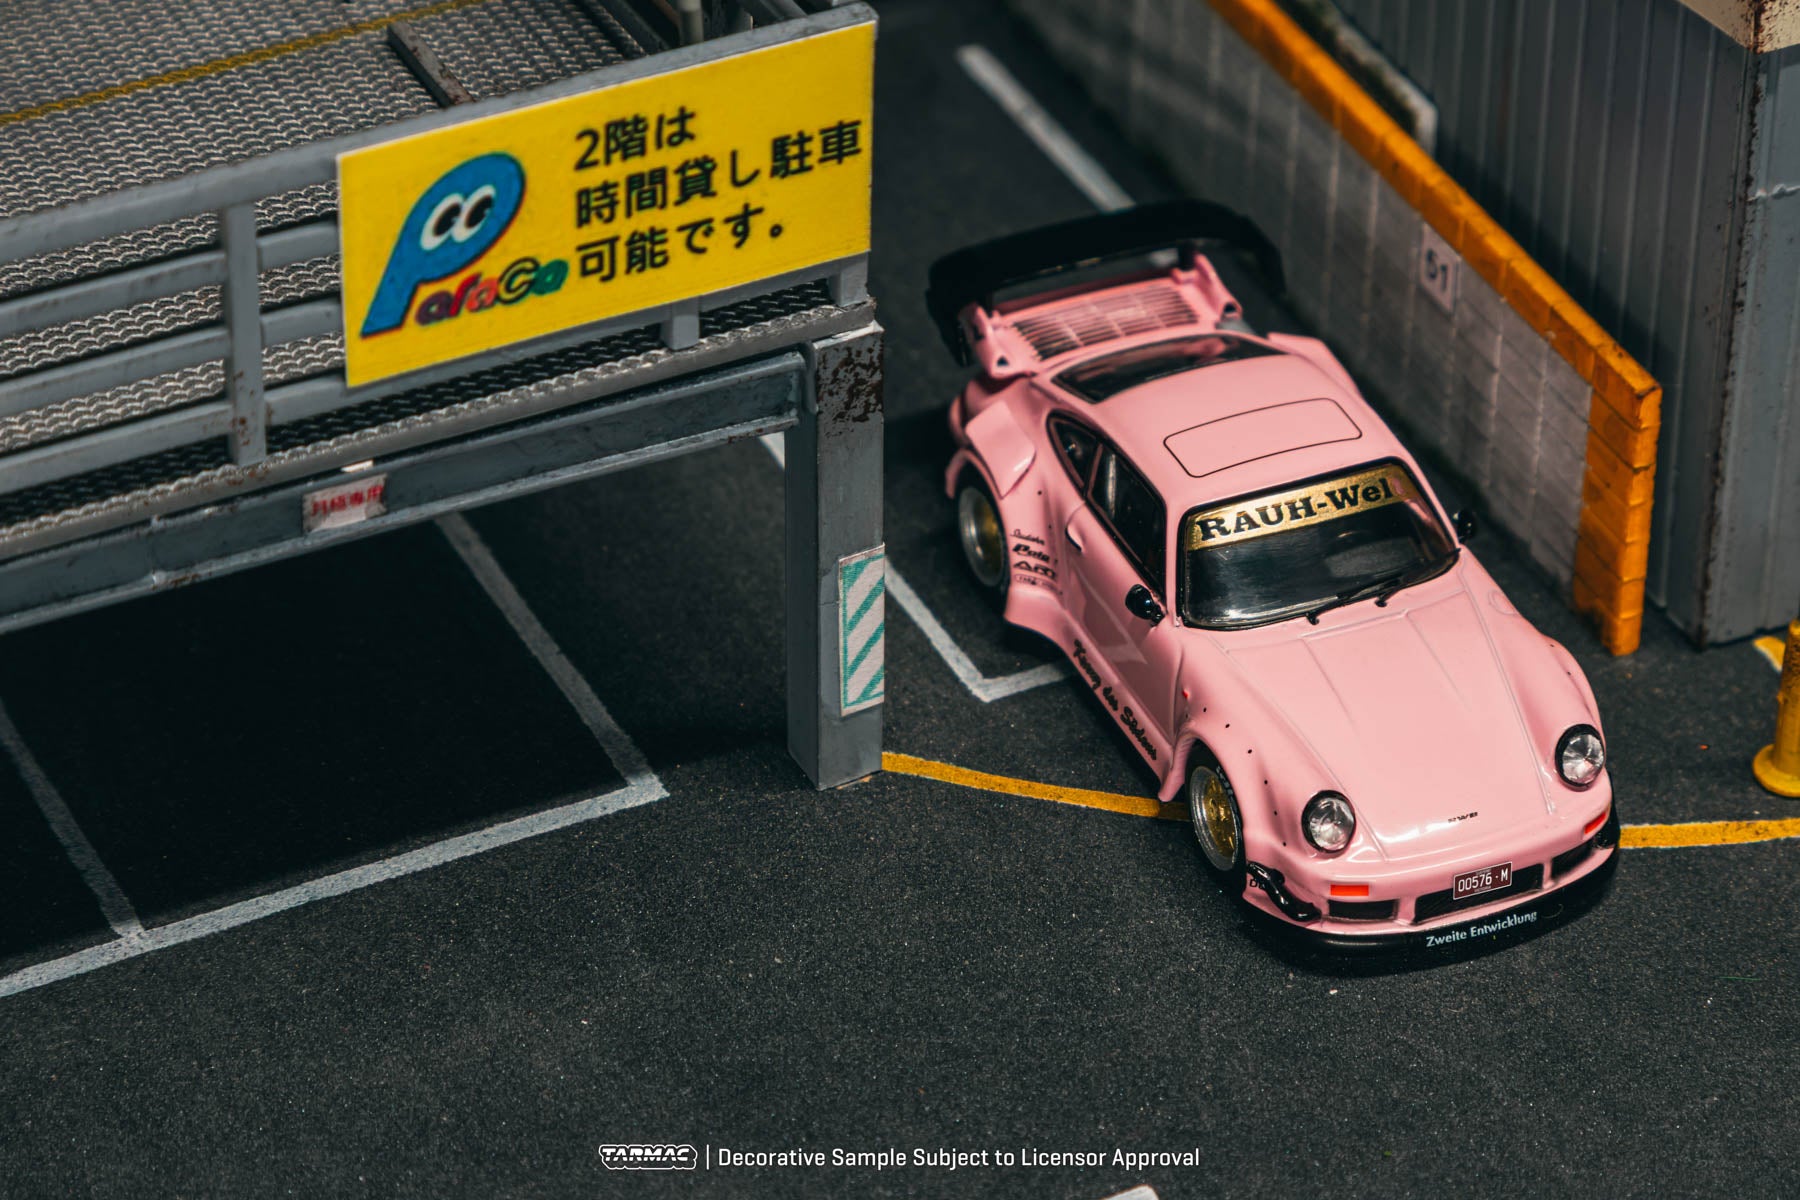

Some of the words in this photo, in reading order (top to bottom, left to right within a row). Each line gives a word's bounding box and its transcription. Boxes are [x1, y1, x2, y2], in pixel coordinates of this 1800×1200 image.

[574, 106, 697, 171] 2階は
[575, 119, 862, 229] 時間貸し駐車
[575, 202, 783, 283] 可能です。
[1426, 248, 1448, 292] 51
[1458, 872, 1493, 893] 00576
[1426, 930, 1467, 948] Zweite
[1470, 911, 1538, 938] Entwicklung
